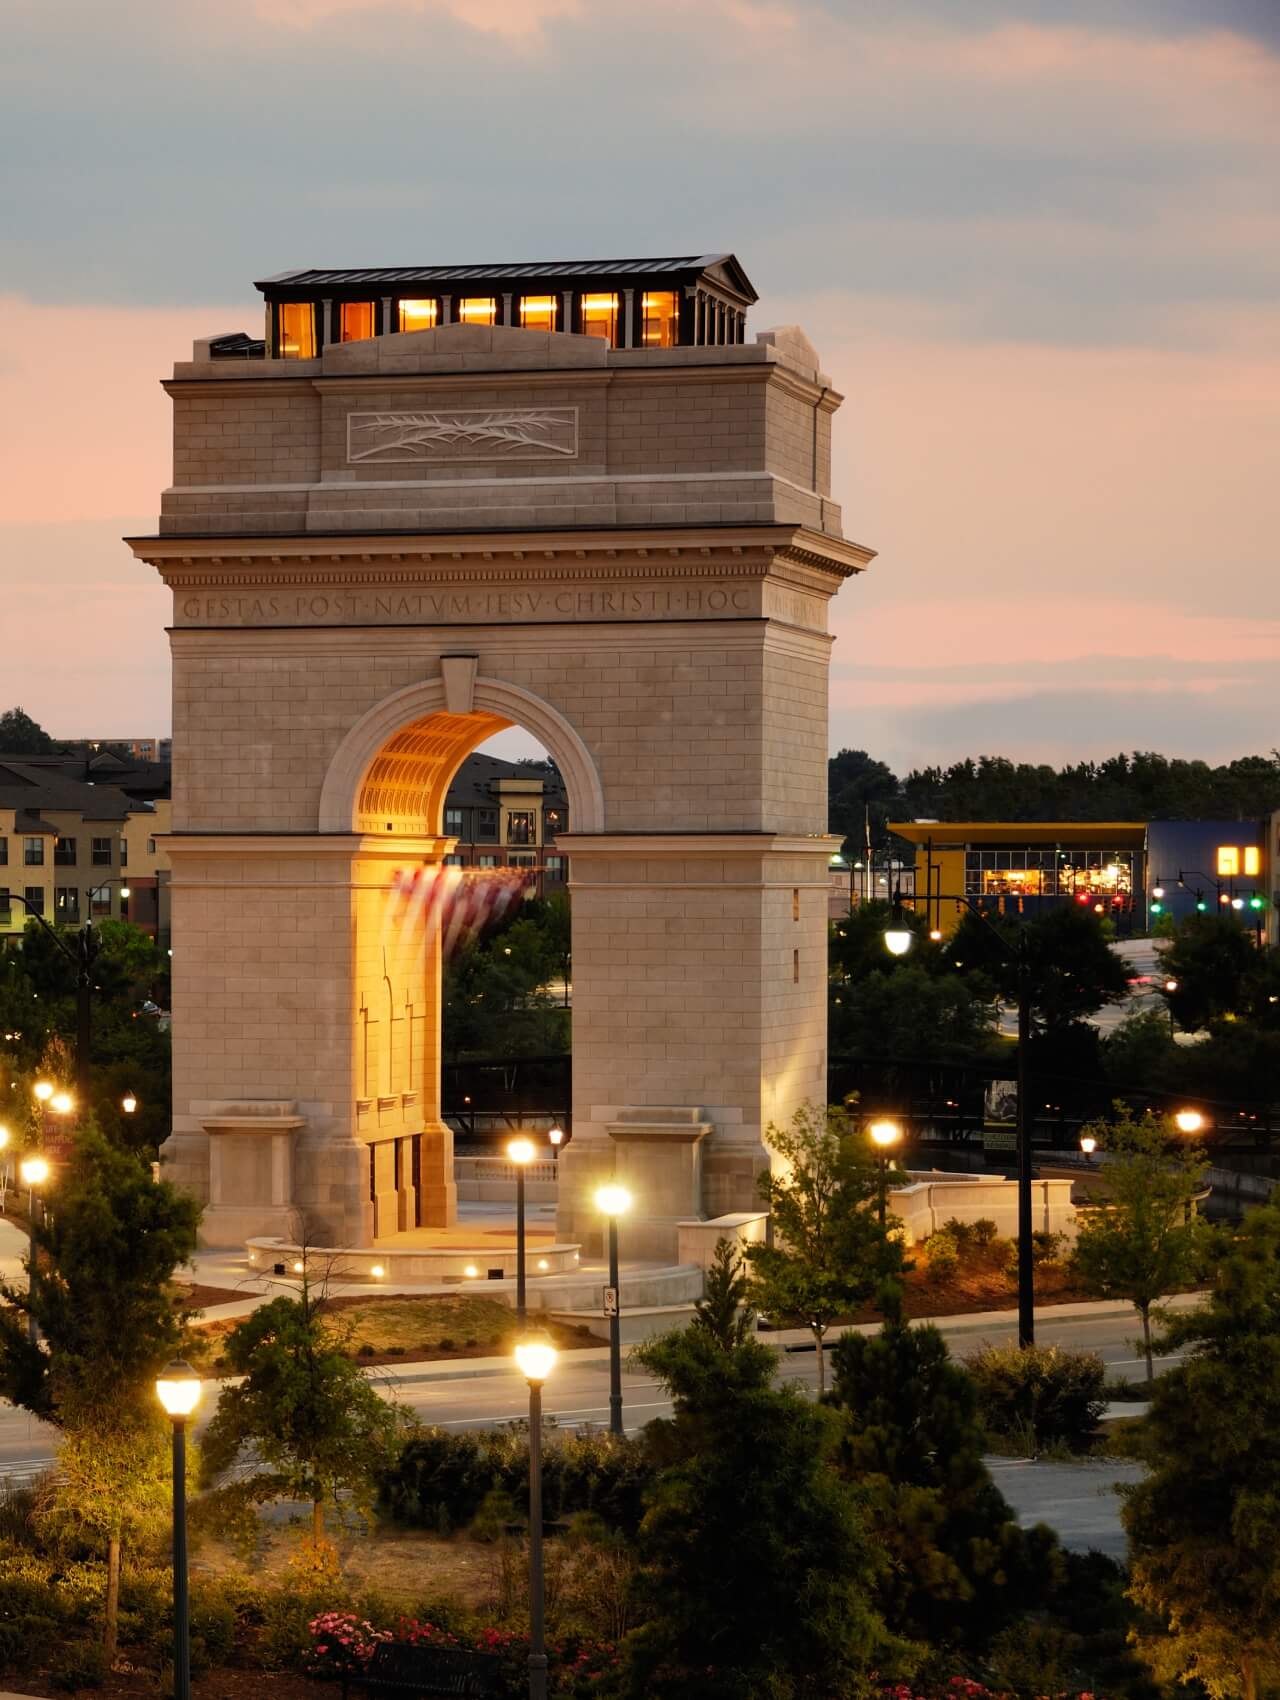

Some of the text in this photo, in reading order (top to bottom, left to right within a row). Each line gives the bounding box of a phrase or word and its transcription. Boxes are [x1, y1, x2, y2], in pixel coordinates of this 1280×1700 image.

[183, 598, 280, 618] GESTAS
[295, 596, 363, 617] POST
[375, 595, 471, 616] NATVM
[555, 591, 671, 612] CHRISTI
[685, 589, 750, 611] HOC
